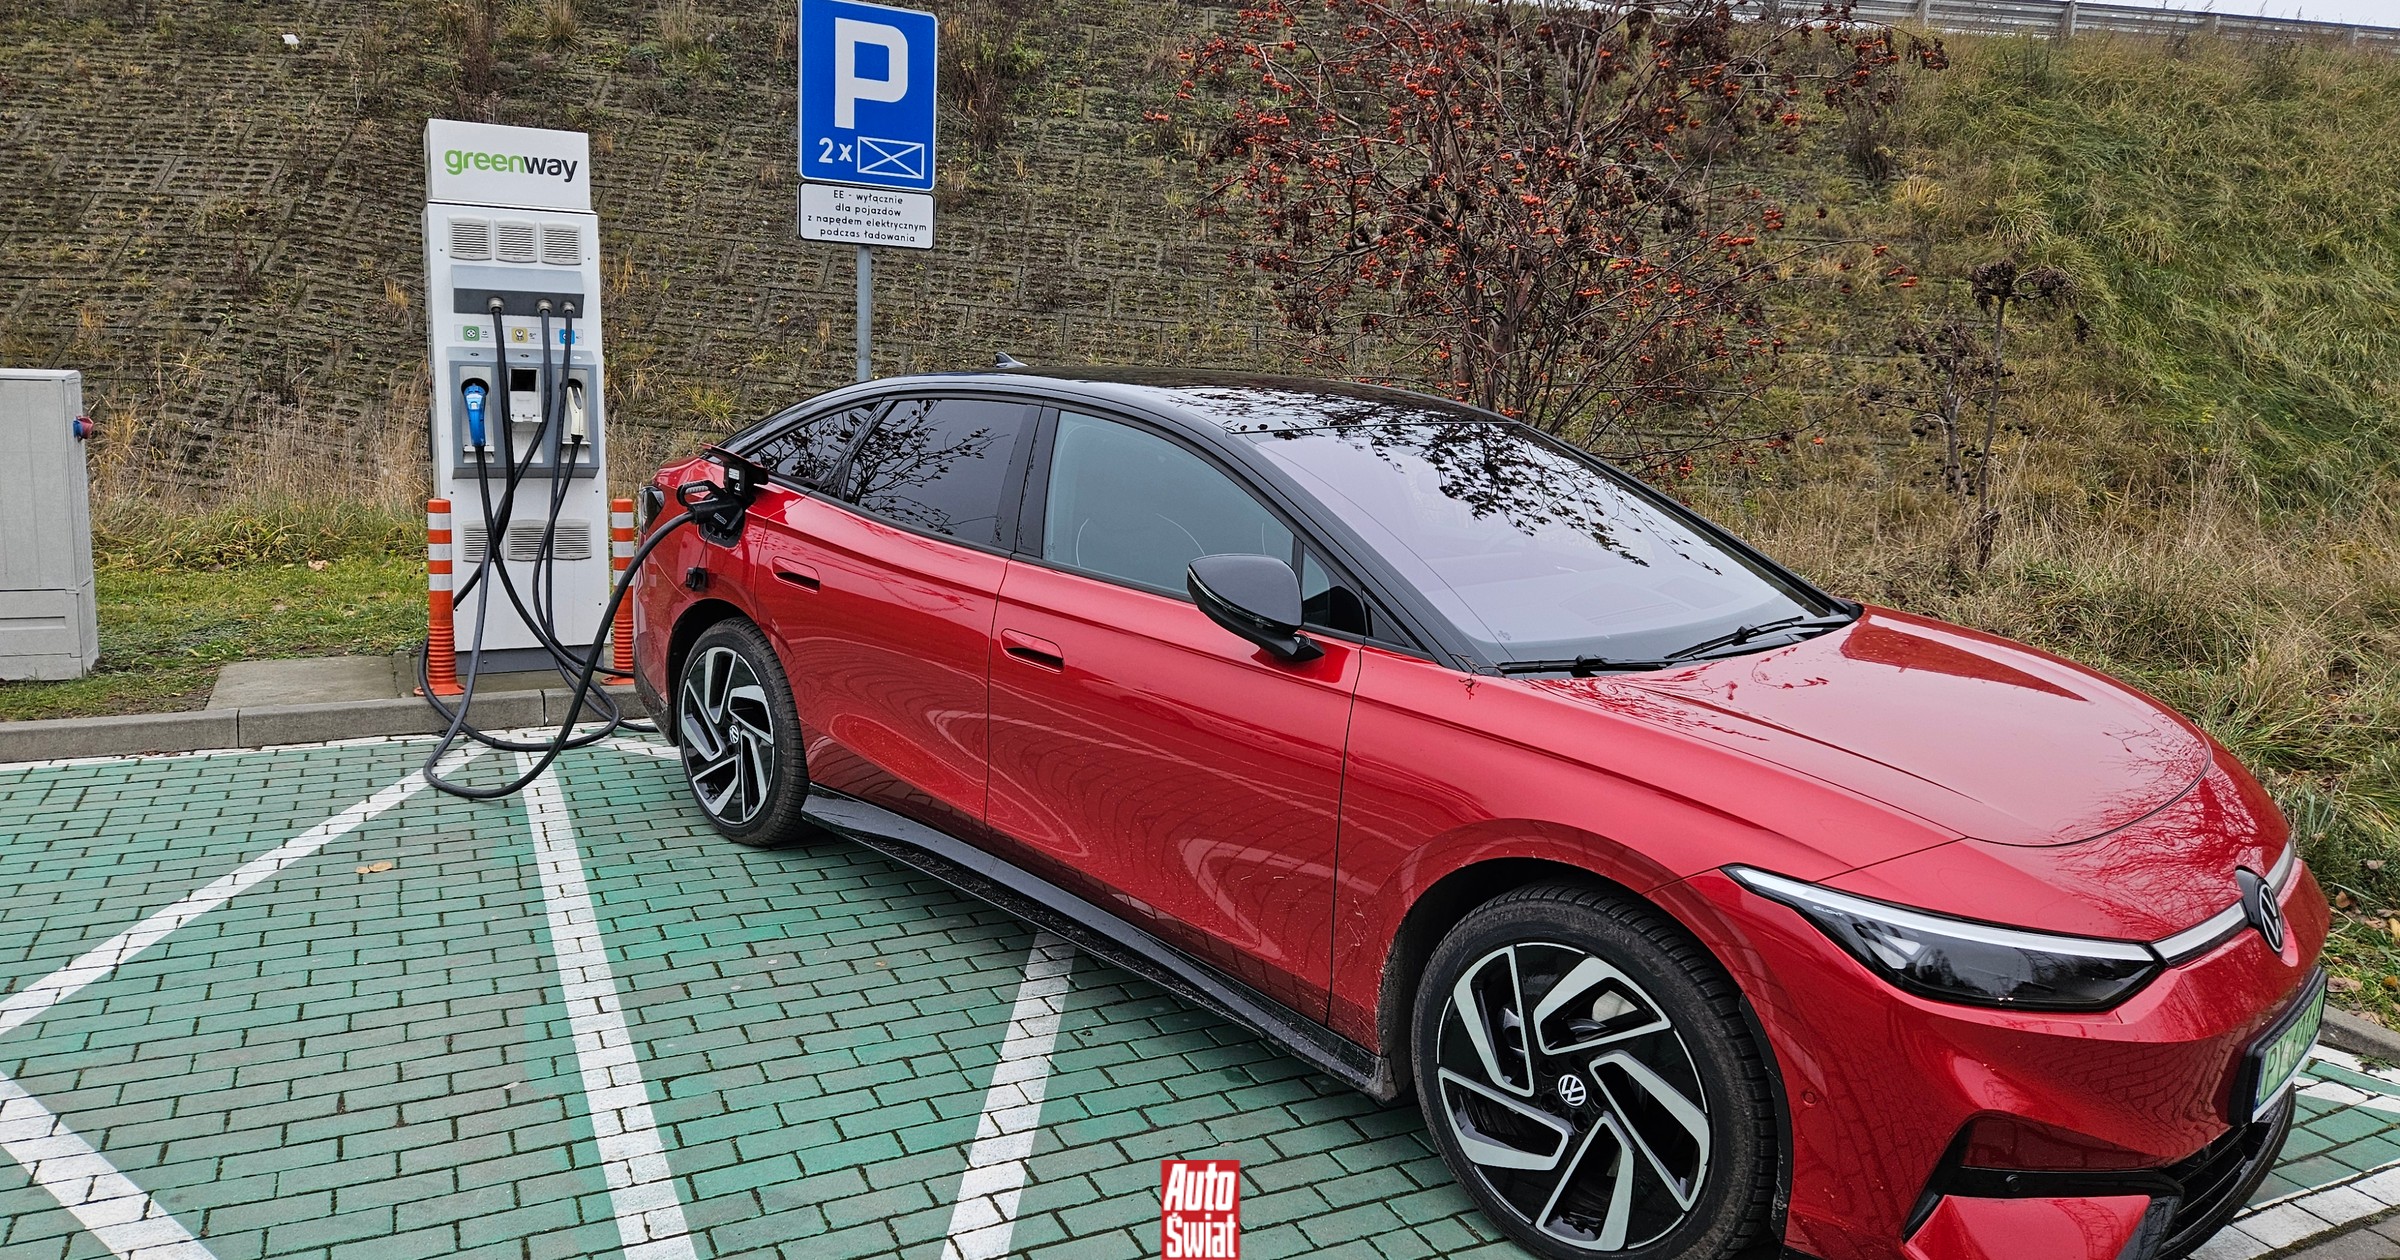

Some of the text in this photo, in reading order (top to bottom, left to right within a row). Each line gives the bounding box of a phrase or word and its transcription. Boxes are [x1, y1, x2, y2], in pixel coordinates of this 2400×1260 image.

[834, 17, 909, 130] P
[444, 149, 578, 183] greenway
[833, 189, 845, 199] EE
[855, 192, 904, 205] wyłącznie
[835, 203, 902, 217] dla pojazdów
[816, 215, 863, 226] napędem
[865, 219, 928, 232] elektrycznym
[819, 228, 916, 242] podczas ładowania
